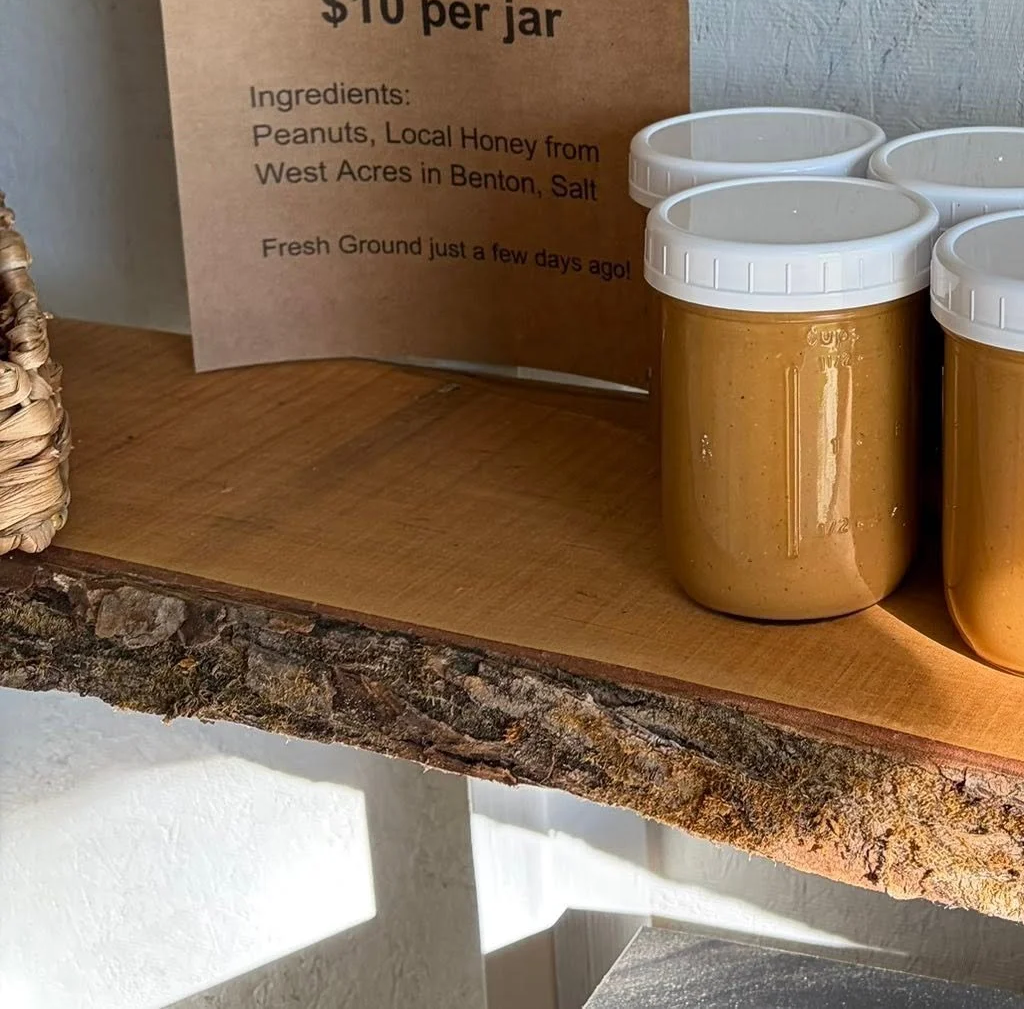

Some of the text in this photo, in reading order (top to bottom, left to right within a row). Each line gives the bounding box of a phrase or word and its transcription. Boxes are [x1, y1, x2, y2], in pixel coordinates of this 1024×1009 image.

[249, 81, 411, 113] Ingredients:
[252, 120, 600, 164] Peanuts, Local Honey from
[254, 158, 598, 202] West Acres in Benton, Salt
[261, 234, 633, 283] Fresh Ground just a few days ago!
